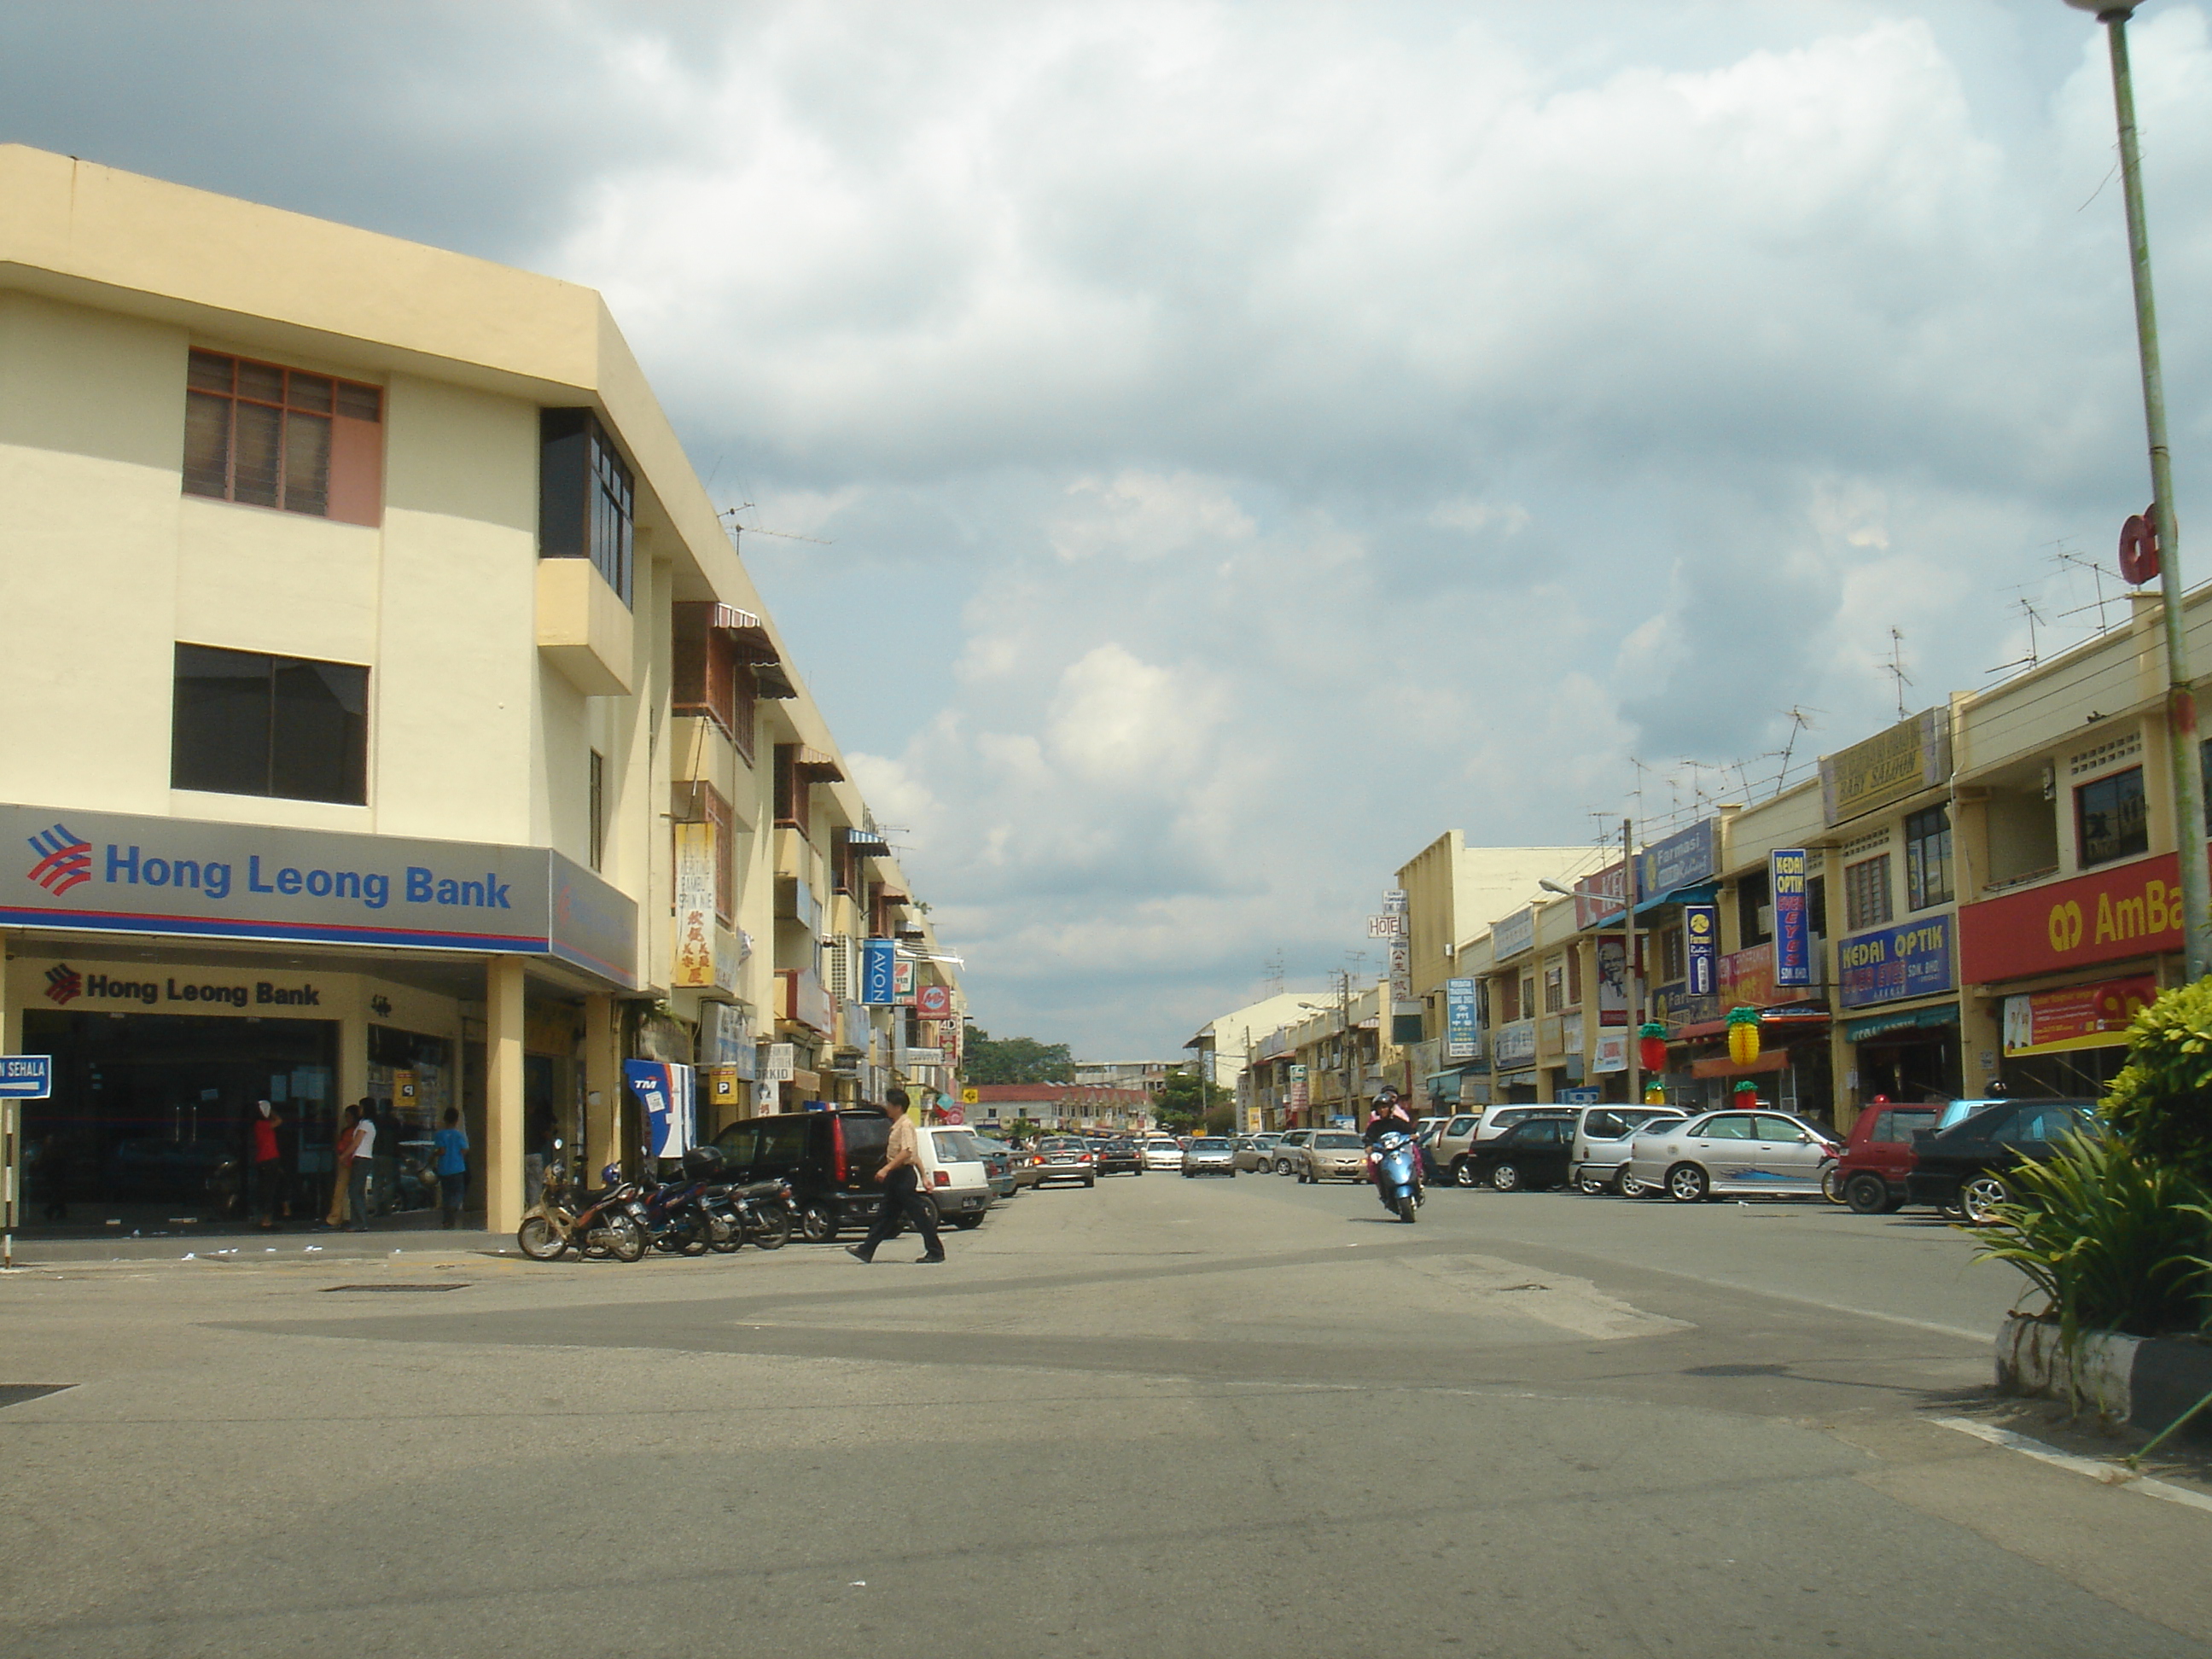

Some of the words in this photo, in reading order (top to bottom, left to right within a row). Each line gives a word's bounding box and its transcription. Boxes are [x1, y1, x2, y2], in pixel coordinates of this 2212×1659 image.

[1776, 857, 1804, 875] KEDAI
[106, 845, 231, 899] Hong
[248, 855, 389, 909] Leong
[405, 866, 511, 910] Bank
[1777, 876, 1805, 894] OPTIK
[1778, 897, 1805, 911] EVER
[2095, 880, 2185, 945] AmBa
[1370, 917, 1407, 936] HOTEL
[1843, 940, 1885, 969] KEDAI
[1895, 925, 1943, 958] OPTIK
[873, 951, 886, 1002] AVON
[88, 975, 158, 1004] Hong
[167, 978, 247, 1006] Leong
[256, 981, 319, 1006] Bank
[940, 1019, 956, 1030] 4D
[8, 1061, 45, 1077] SEHALA
[634, 1080, 656, 1089] TM
[719, 1082, 729, 1093] P
